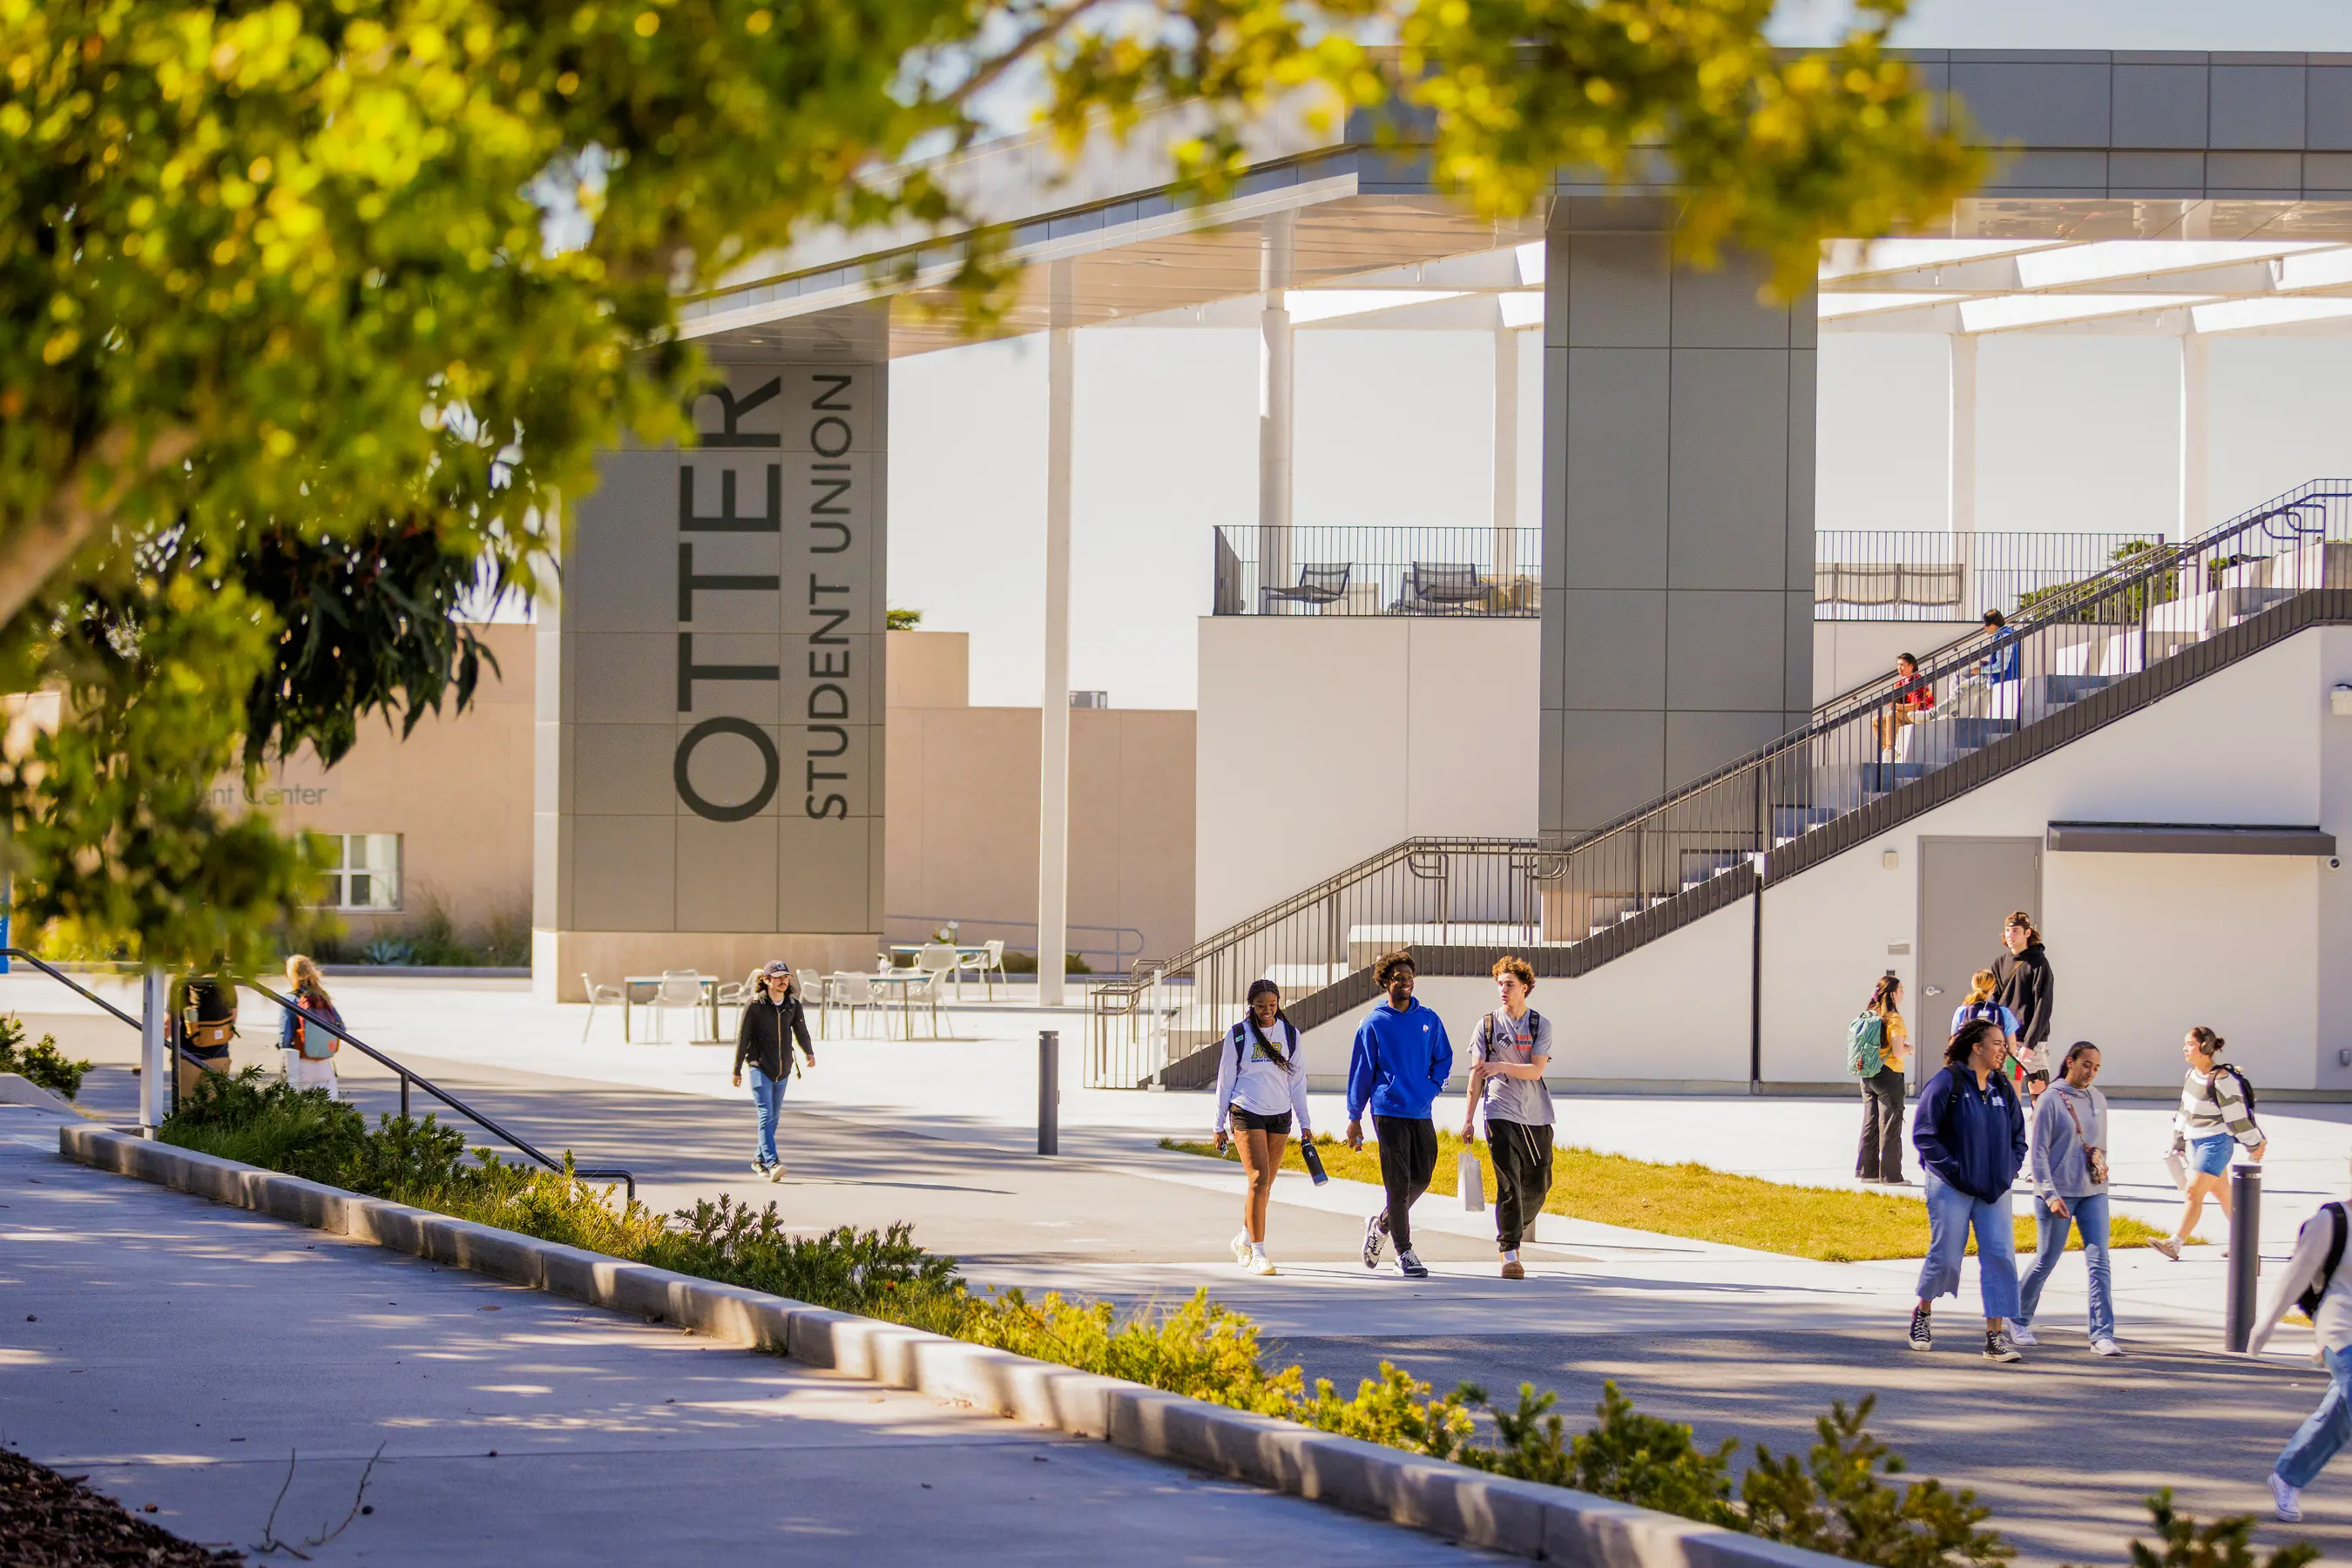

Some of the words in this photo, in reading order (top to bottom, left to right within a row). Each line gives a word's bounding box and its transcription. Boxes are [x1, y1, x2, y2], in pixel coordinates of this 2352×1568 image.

[810, 375, 853, 554] UNION
[673, 375, 781, 822] OTTER
[806, 573, 851, 821] STUDENT
